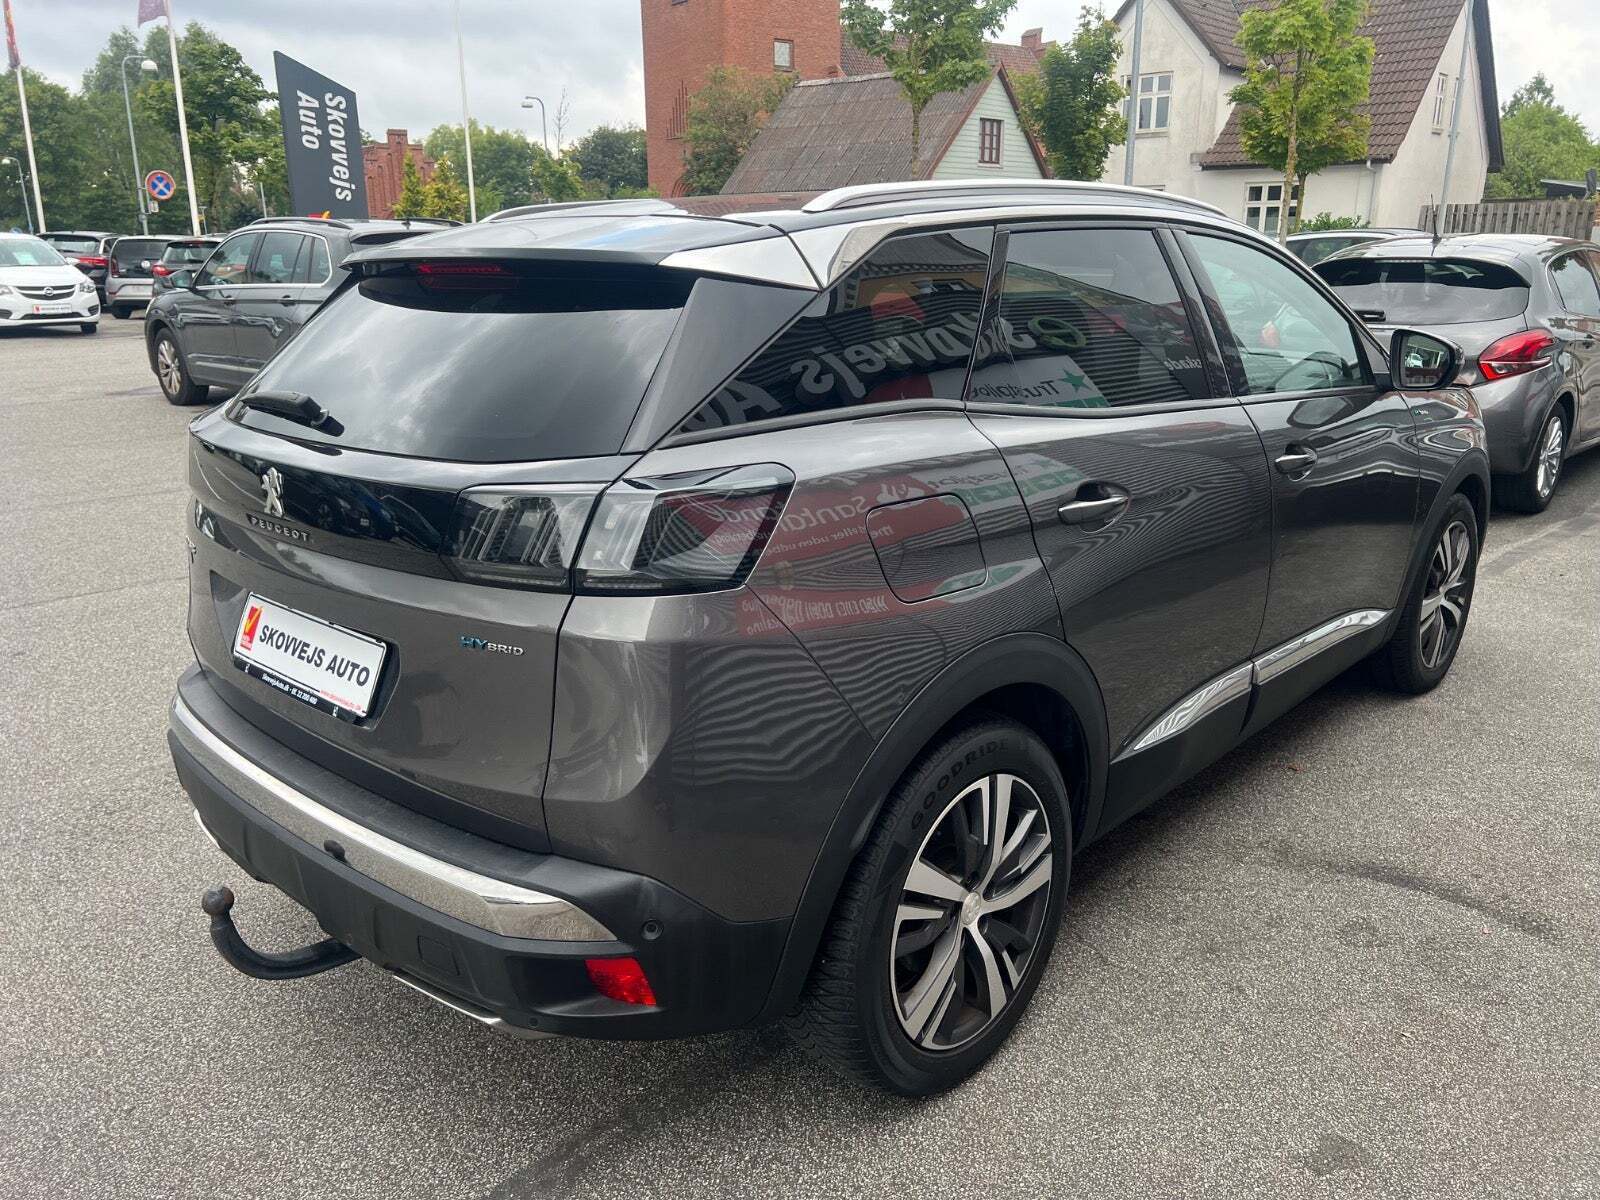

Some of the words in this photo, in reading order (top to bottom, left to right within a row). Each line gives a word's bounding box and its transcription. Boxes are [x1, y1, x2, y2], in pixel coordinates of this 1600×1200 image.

[296, 90, 322, 150] Auto
[325, 92, 356, 202] Skovvejs
[250, 514, 310, 541] PEUGEOT
[259, 625, 326, 667] SKOVVEJS
[326, 654, 370, 687] AUTO
[460, 635, 524, 656] HYBRID
